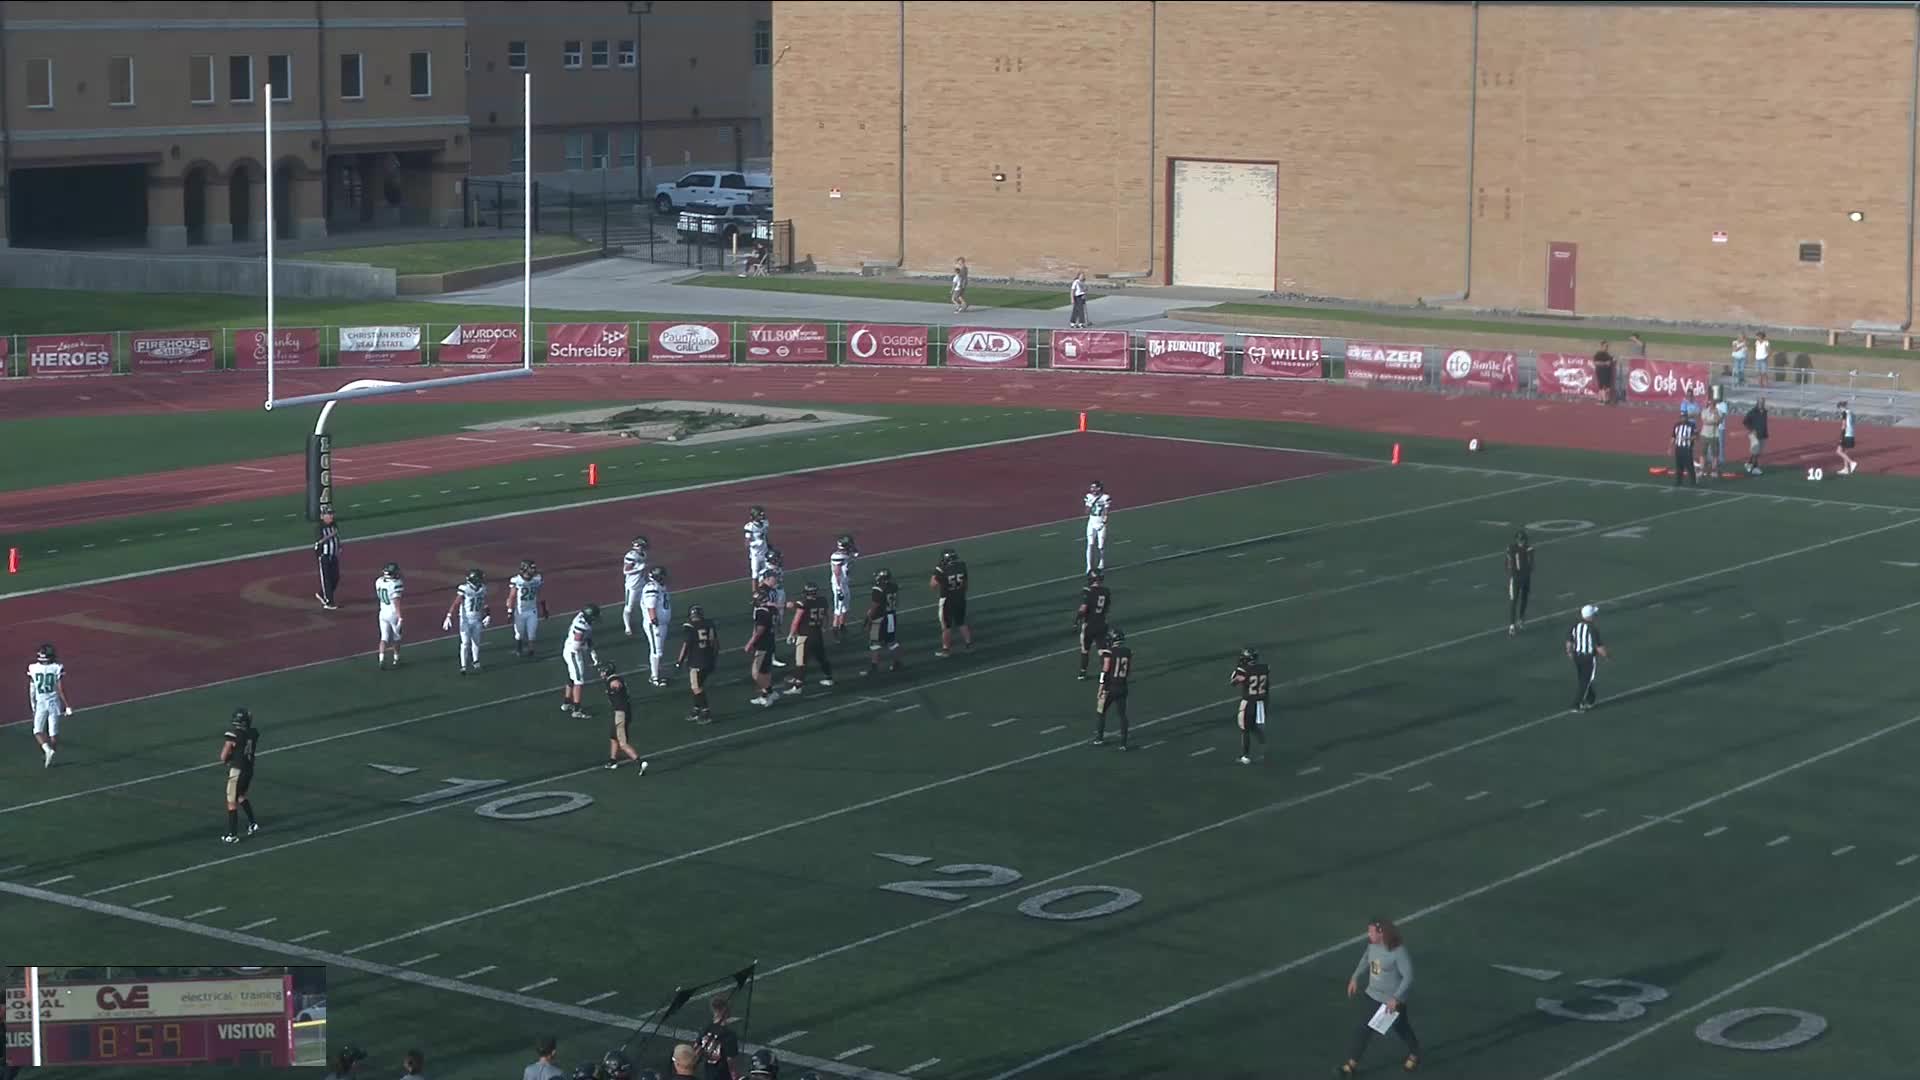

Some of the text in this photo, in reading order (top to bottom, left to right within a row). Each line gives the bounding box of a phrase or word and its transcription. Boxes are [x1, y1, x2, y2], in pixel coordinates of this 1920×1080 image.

[463, 329, 517, 338] MURDOCK
[881, 335, 922, 346] OGDEN
[137, 340, 209, 353] FIREHOUSE
[550, 343, 625, 357] Schreiber
[881, 347, 922, 357] CLINIC
[1167, 340, 1222, 360] FURNITURE
[31, 352, 110, 367] HEROES
[1271, 348, 1319, 361] WILLIS
[1807, 468, 1822, 480] 10
[1096, 595, 1105, 613] 9
[1113, 656, 1128, 678] 13
[36, 672, 55, 694] 29
[1248, 674, 1267, 695] 22
[180, 991, 281, 1002] electrical training
[217, 1024, 276, 1040] VISITOR
[99, 1024, 181, 1057] 8:59
